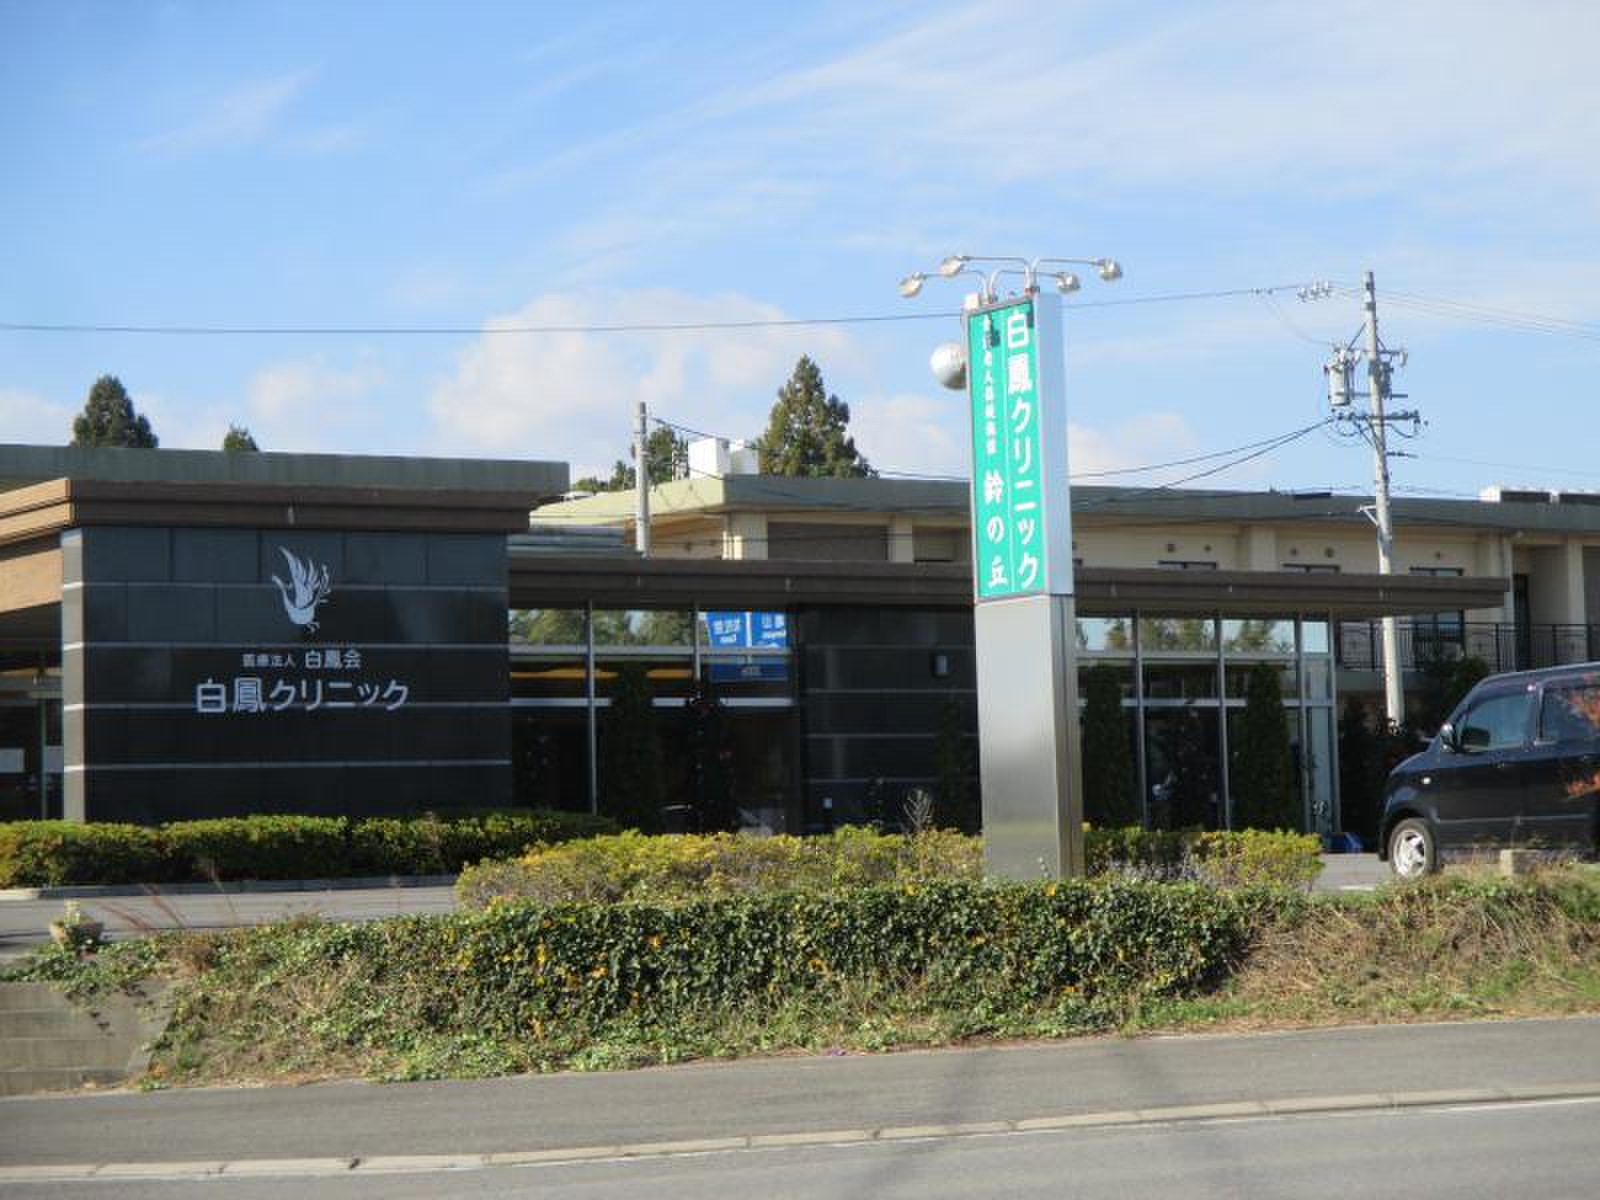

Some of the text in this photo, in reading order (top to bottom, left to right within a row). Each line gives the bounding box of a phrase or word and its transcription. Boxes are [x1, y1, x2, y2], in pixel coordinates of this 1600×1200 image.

[1007, 308, 1039, 590] 白鳳クリニック
[984, 470, 1008, 589] 鈴の丘
[196, 677, 409, 713] 白鳳クリニック
[305, 649, 361, 669] 白鳳会
